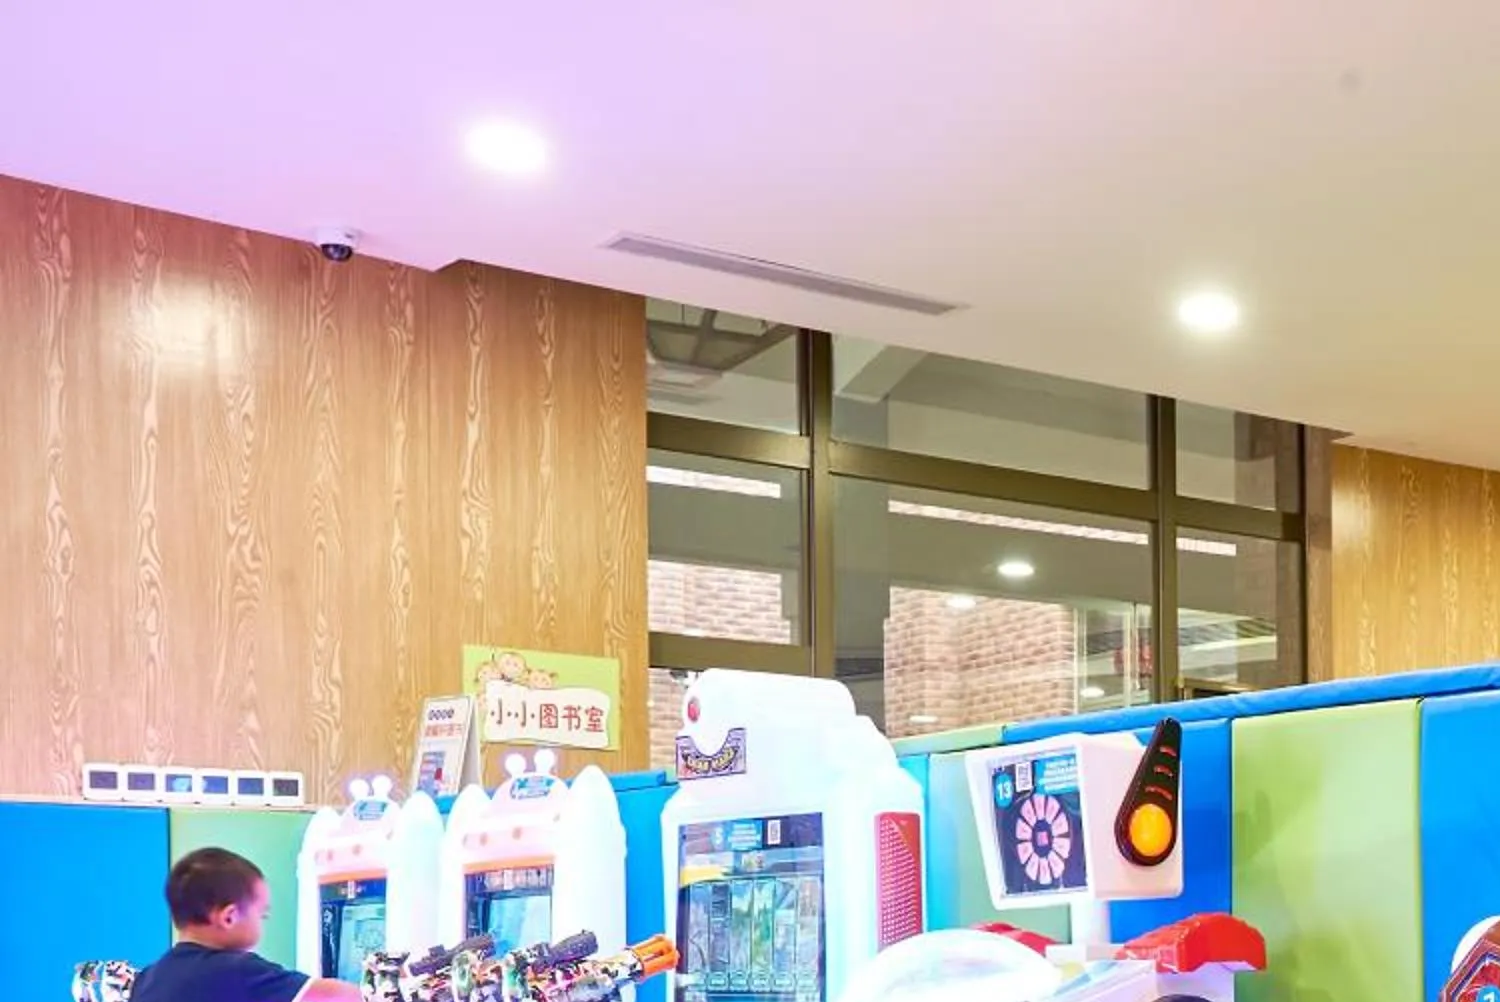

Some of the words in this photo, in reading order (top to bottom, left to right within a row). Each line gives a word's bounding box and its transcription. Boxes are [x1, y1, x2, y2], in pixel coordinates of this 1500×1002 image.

[490, 697, 605, 733] 小小图书室
[998, 781, 1012, 800] 13
